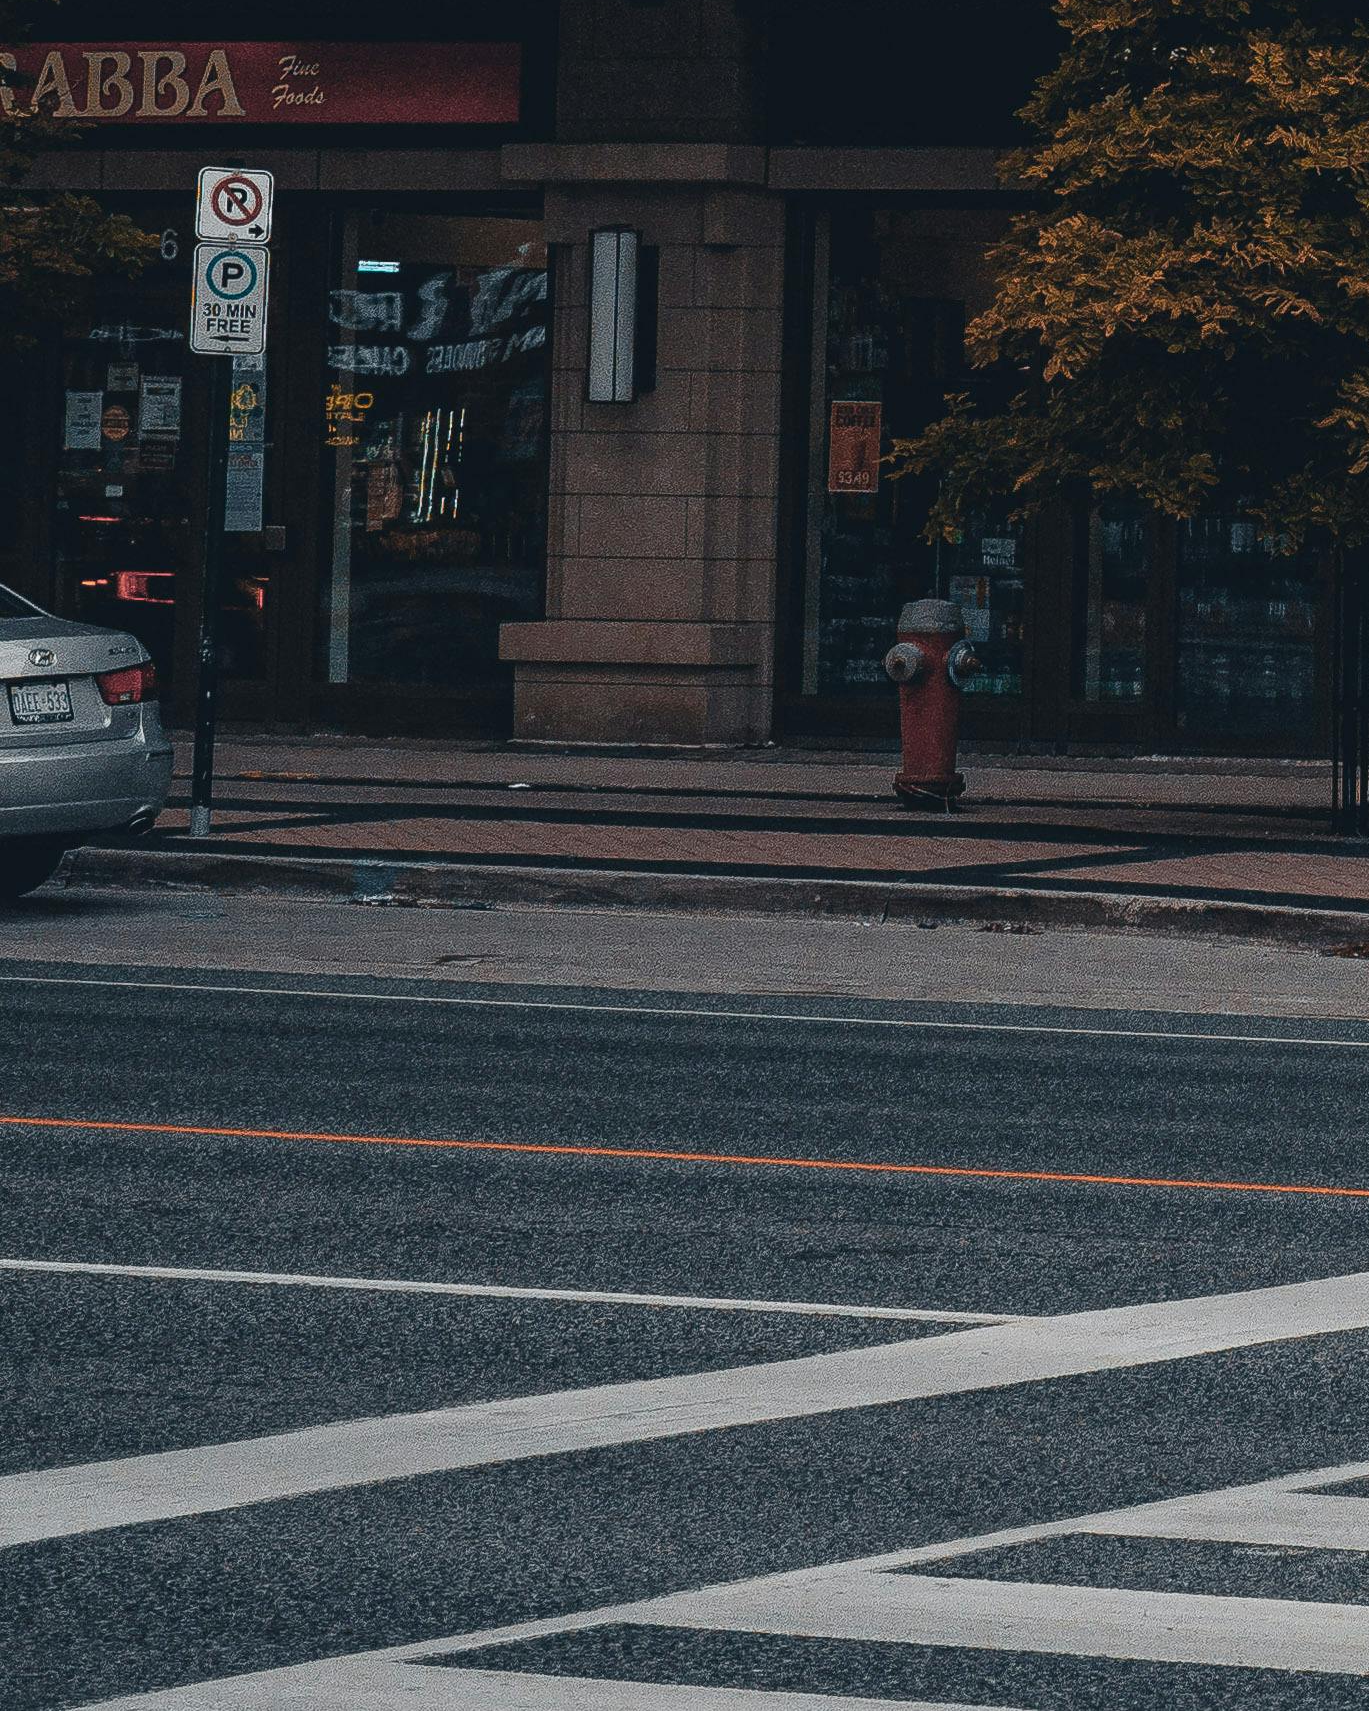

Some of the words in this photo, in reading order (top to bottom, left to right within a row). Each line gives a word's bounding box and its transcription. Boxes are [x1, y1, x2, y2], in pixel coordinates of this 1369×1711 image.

[277, 54, 321, 77] Fine
[271, 84, 328, 110] Foods
[202, 303, 222, 318] 30
[226, 303, 257, 319] MIN
[206, 319, 251, 334] FREE
